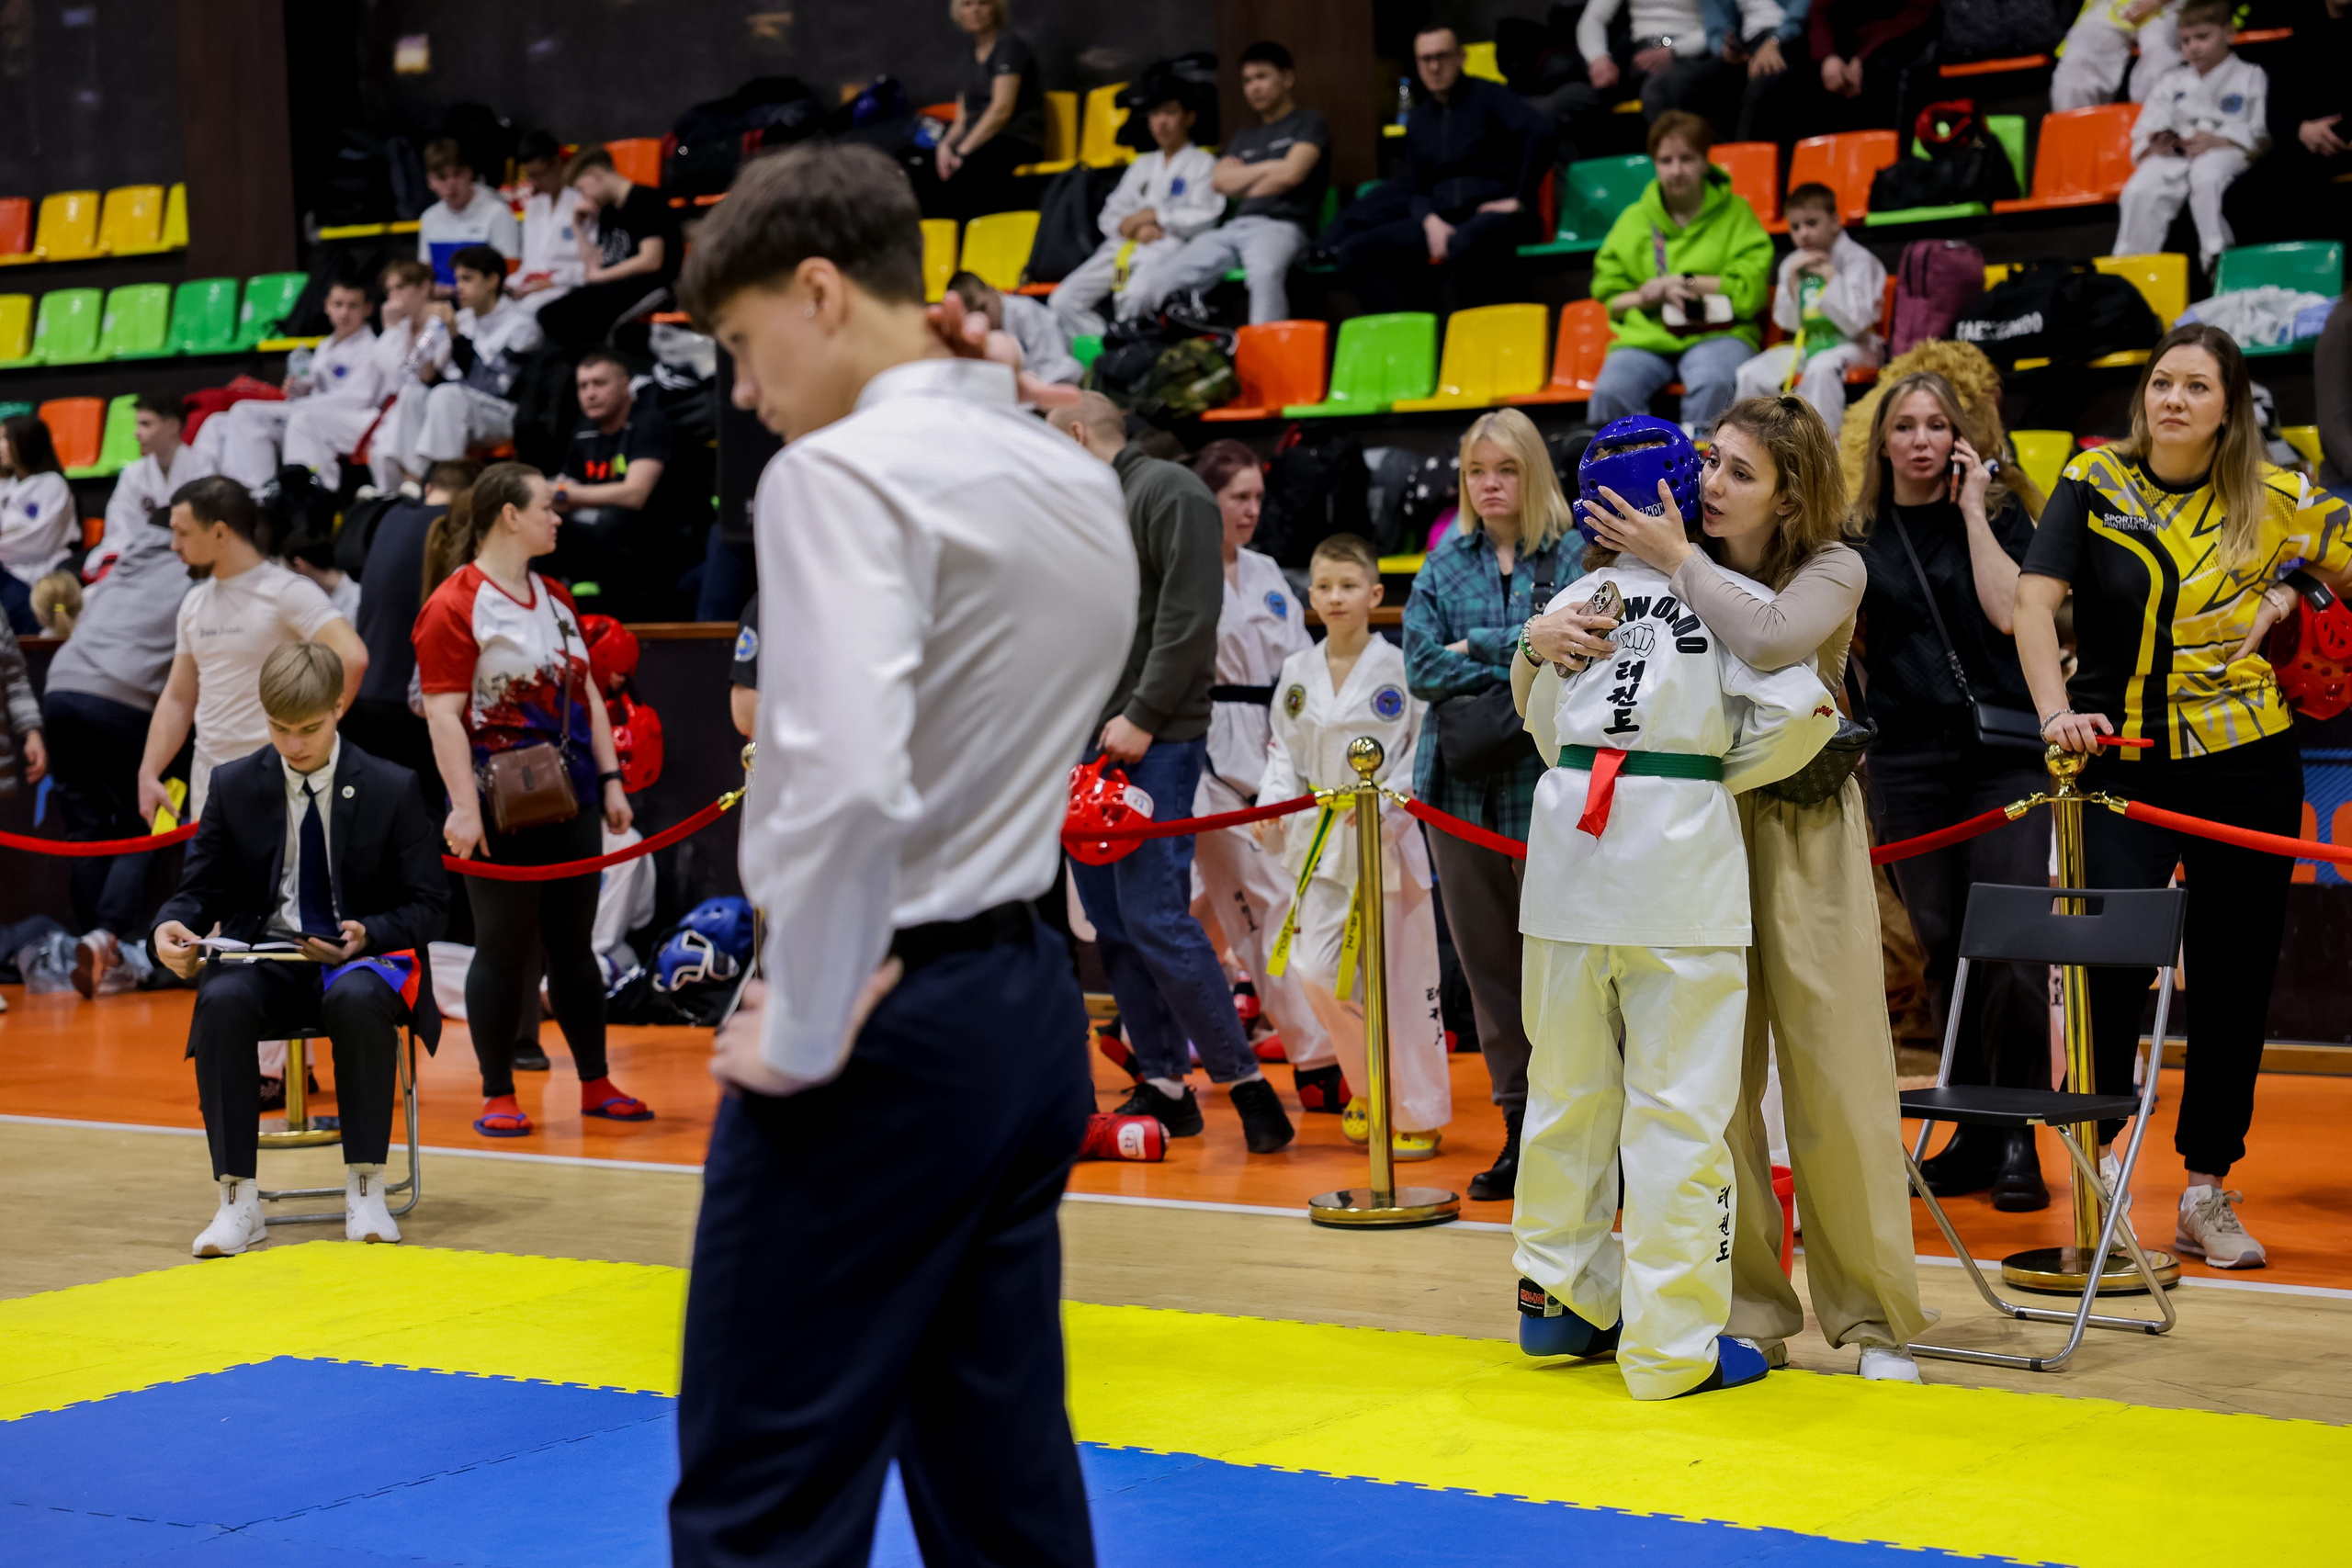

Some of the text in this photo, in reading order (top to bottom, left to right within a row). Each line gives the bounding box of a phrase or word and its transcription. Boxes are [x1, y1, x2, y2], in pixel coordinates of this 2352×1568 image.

[1619, 596, 1708, 654] WONDO
[1603, 660, 1645, 735] 태권도
[1715, 1184, 1731, 1263] 태권도
